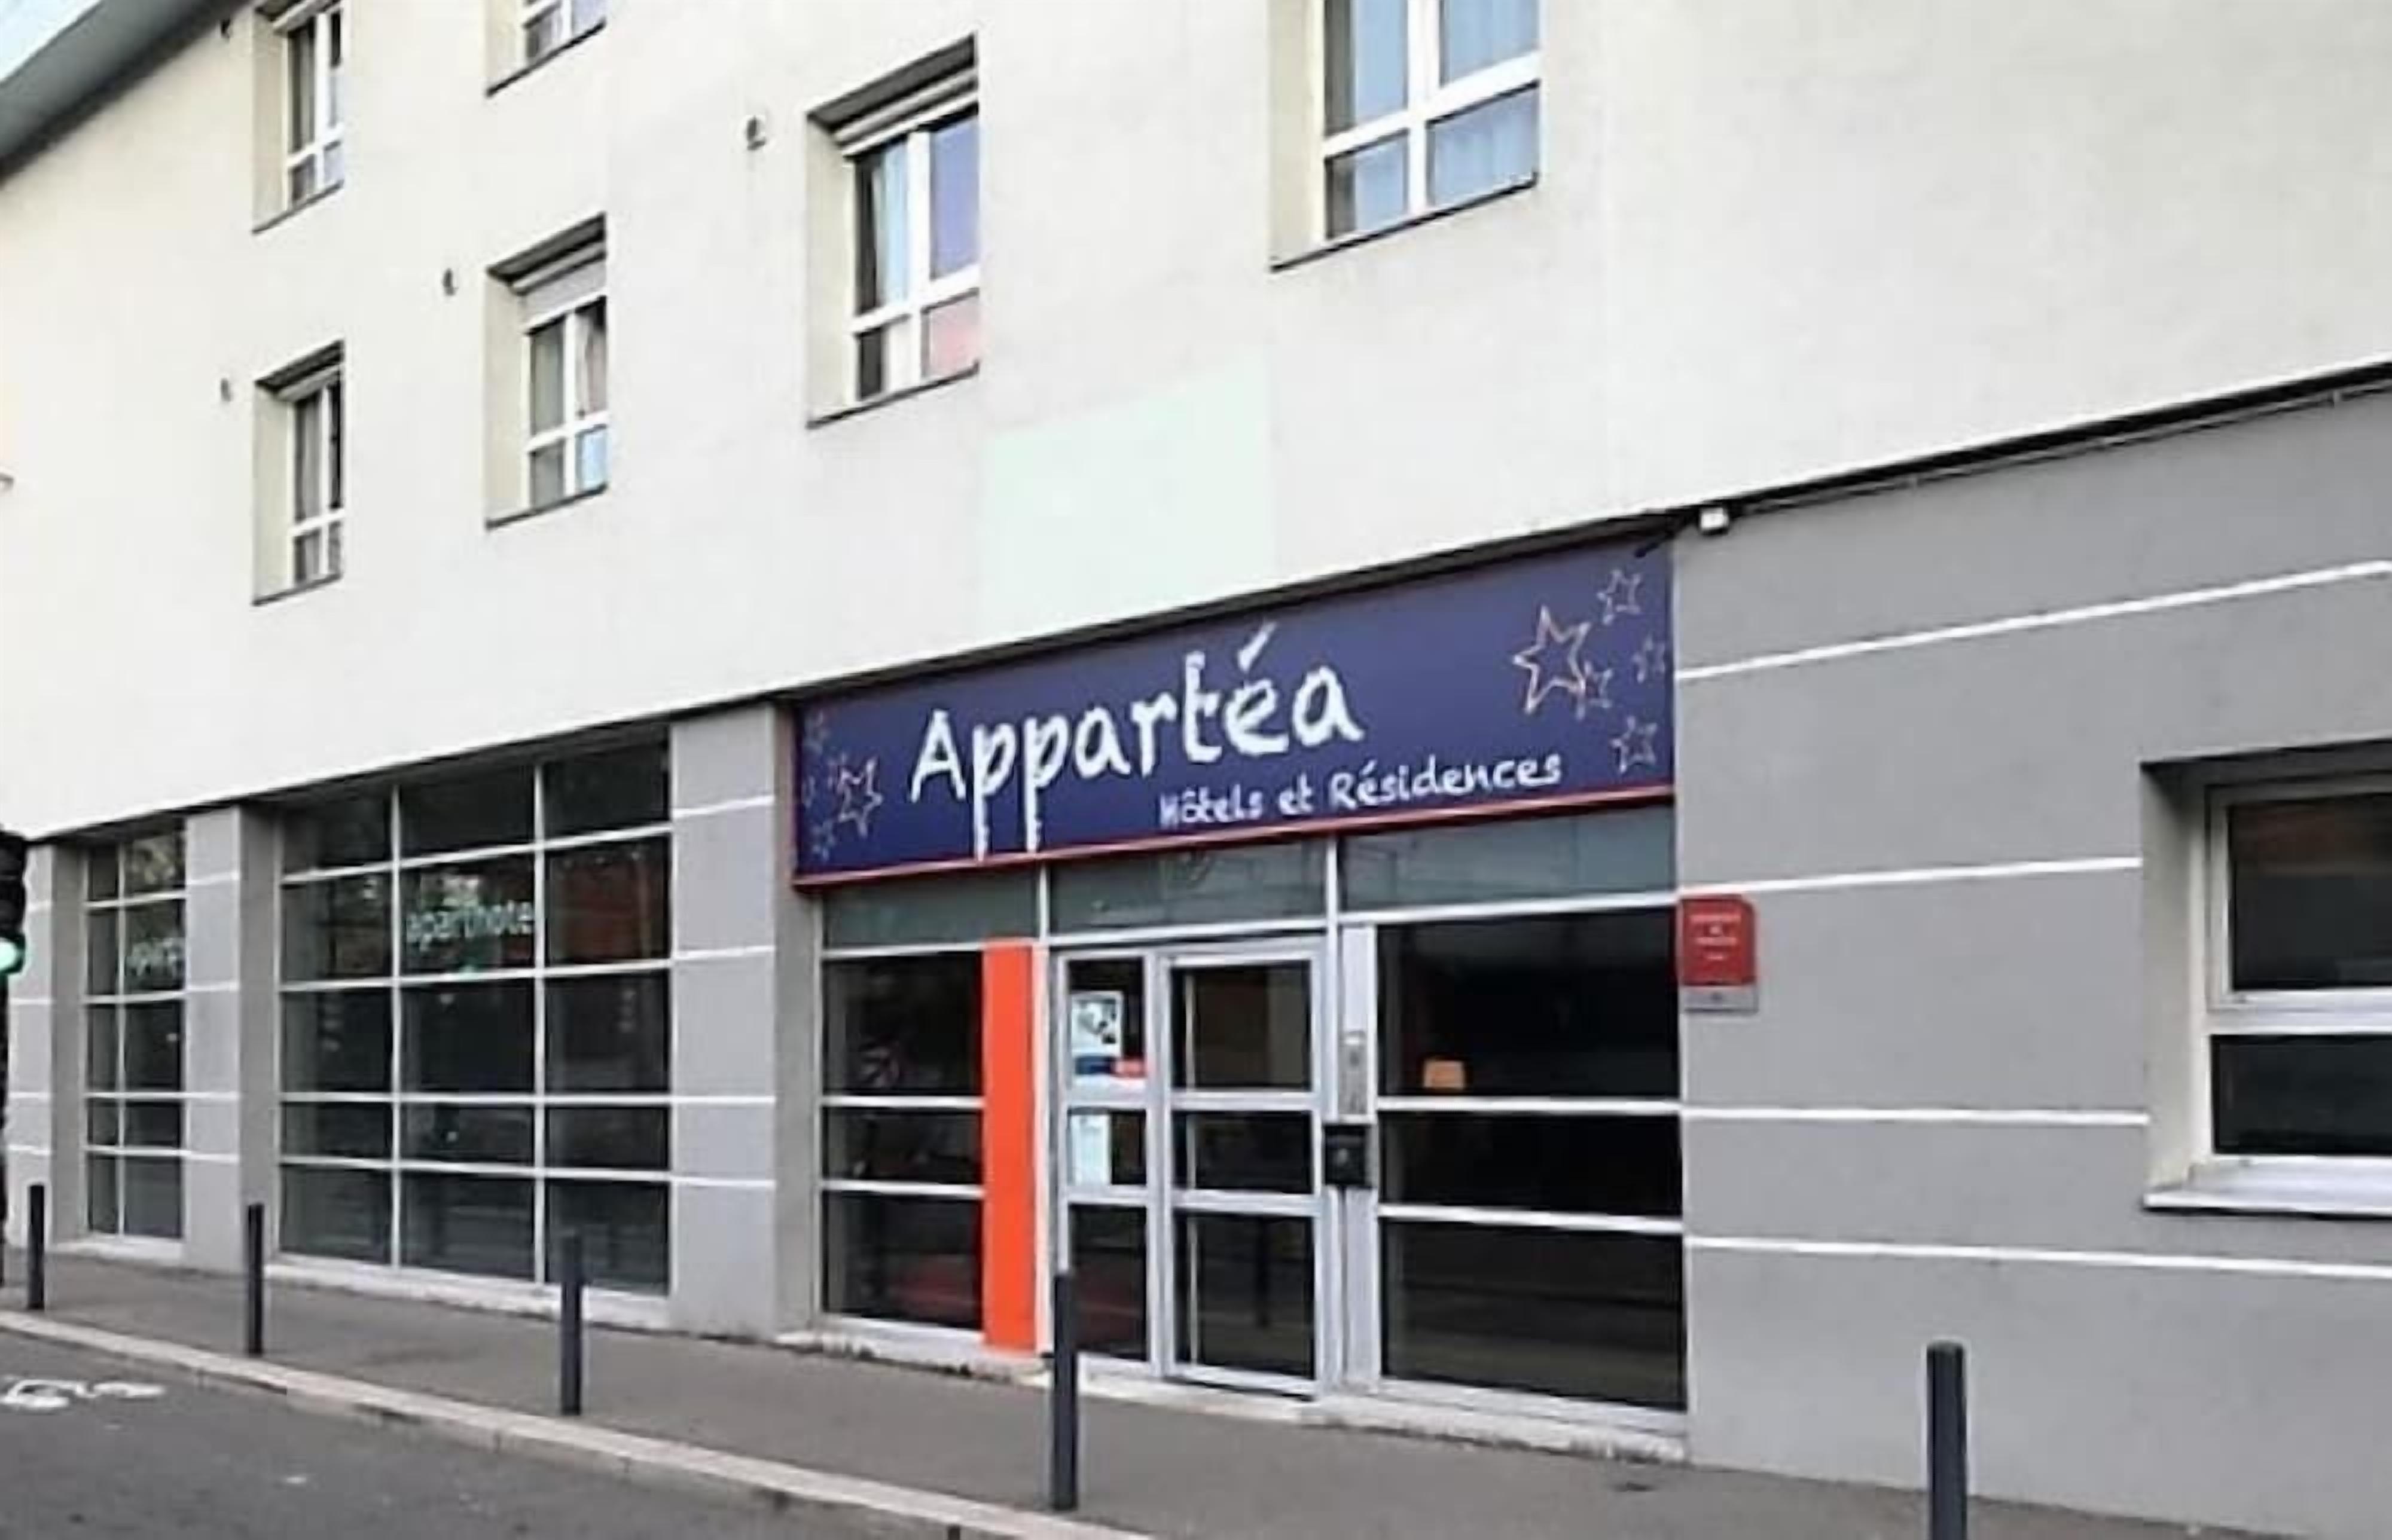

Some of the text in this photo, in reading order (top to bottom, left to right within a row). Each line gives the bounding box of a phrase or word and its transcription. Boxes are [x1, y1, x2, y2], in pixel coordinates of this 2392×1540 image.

[910, 621, 1365, 861] Appartéa
[1160, 758, 1562, 829] Hôtels et Résidences
